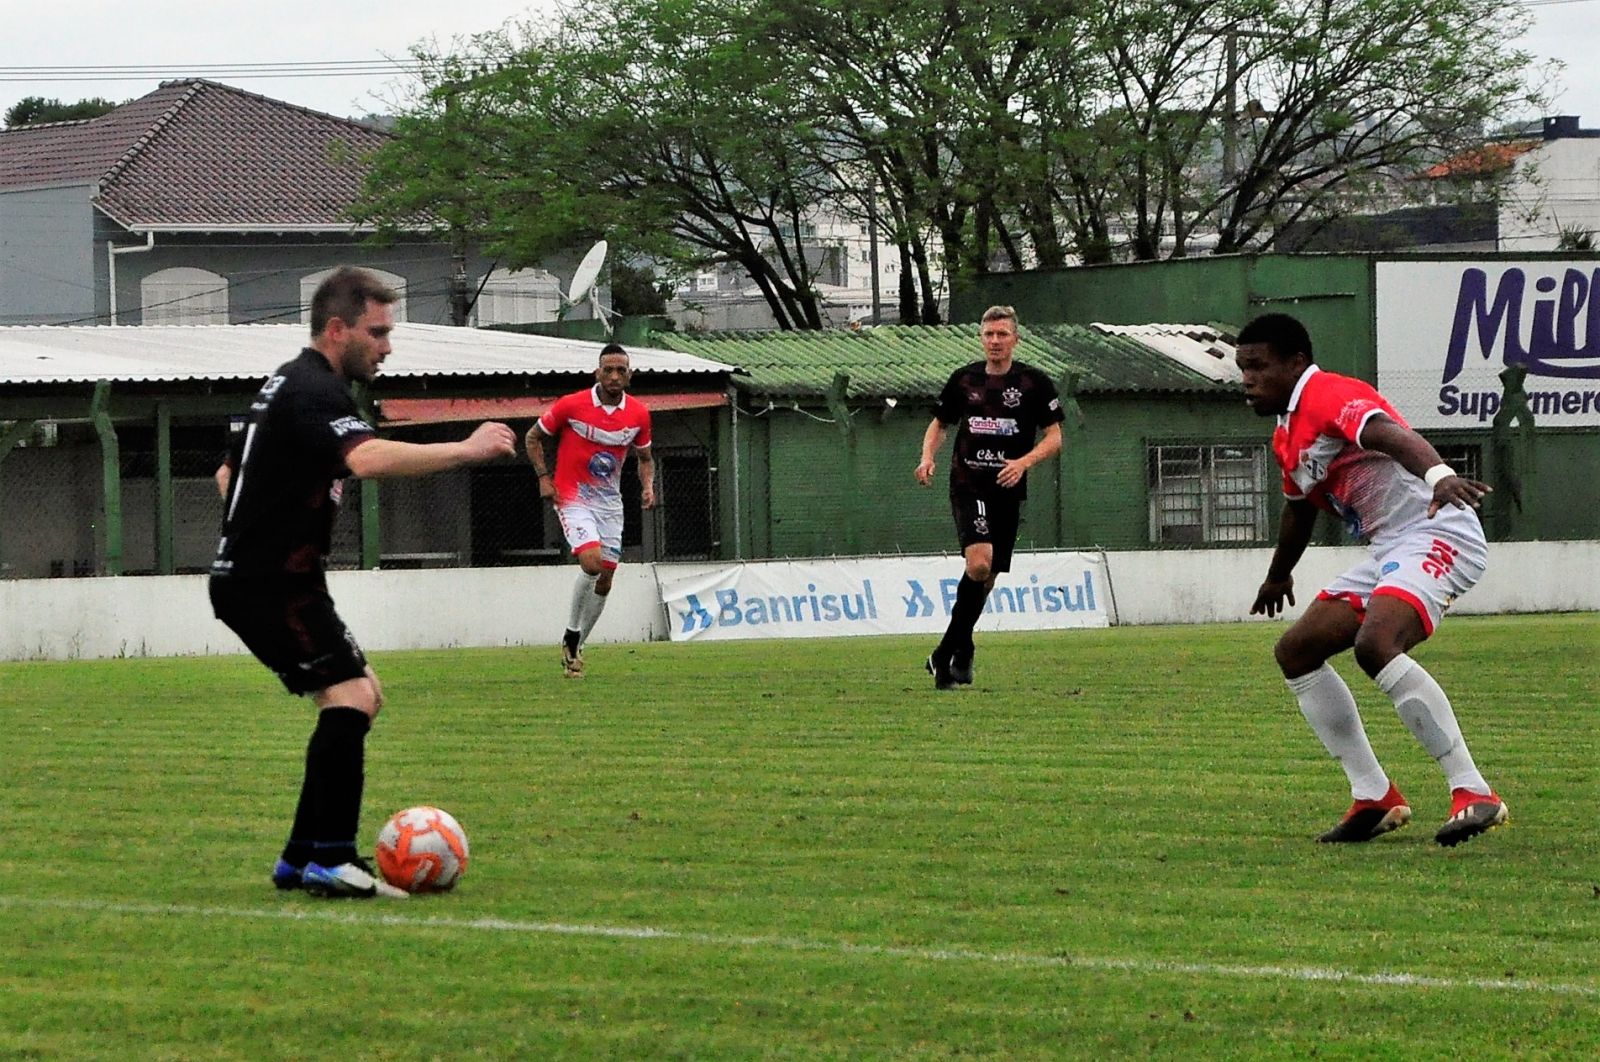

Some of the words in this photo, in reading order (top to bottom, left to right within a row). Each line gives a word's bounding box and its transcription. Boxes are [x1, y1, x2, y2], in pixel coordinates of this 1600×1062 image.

[1437, 384, 1600, 422] Supmer
[715, 578, 878, 628] Banrisul
[939, 570, 1096, 616] Bnrisul
